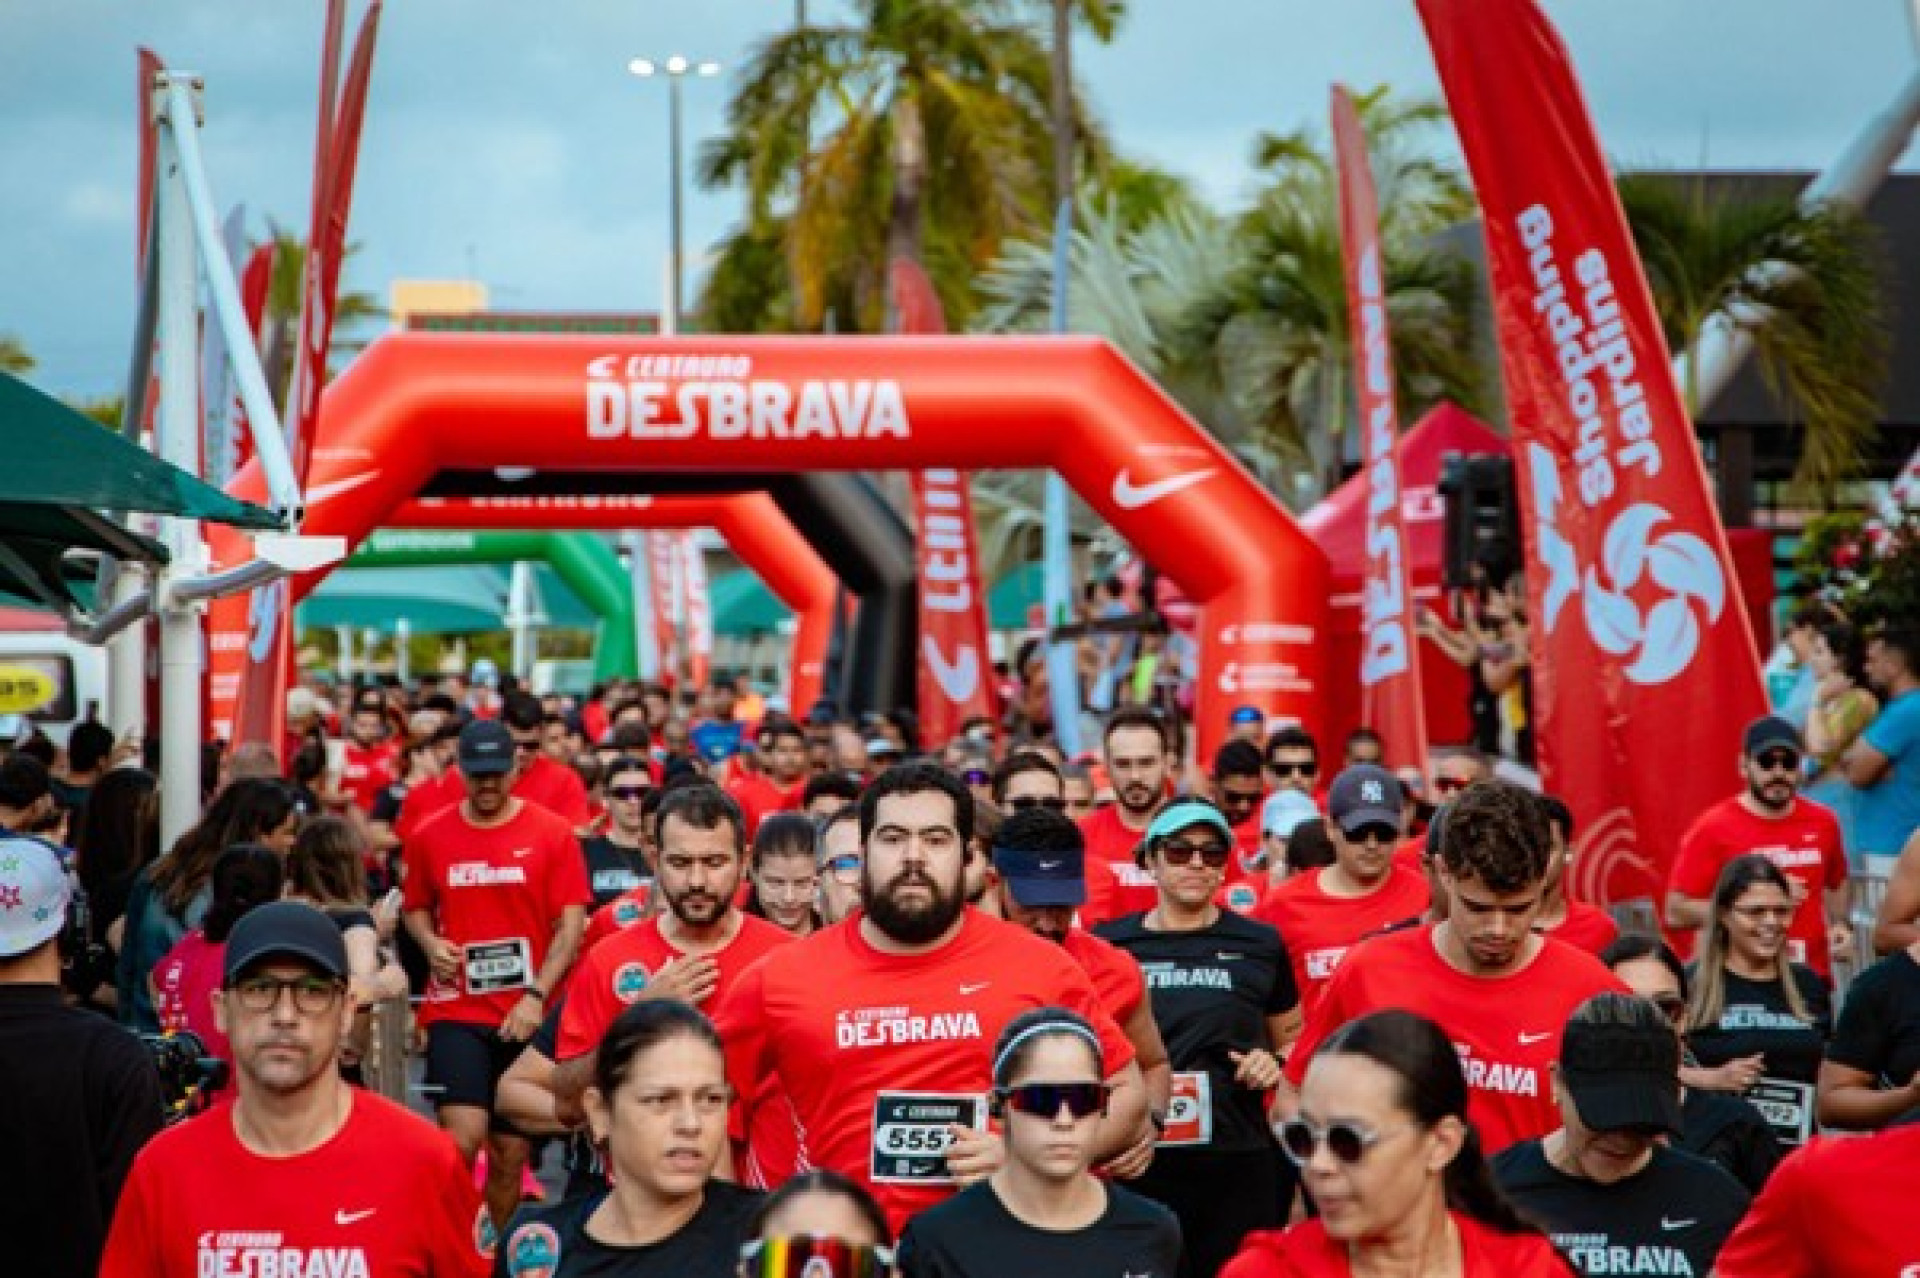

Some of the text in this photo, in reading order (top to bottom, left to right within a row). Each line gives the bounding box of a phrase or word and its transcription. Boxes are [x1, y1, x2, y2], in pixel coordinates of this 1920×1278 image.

[1573, 247, 1663, 477] Jardins
[587, 379, 911, 438] DESBRAVA
[837, 1011, 982, 1049] DESBRAVA
[197, 1246, 371, 1278] DESBRAVA
